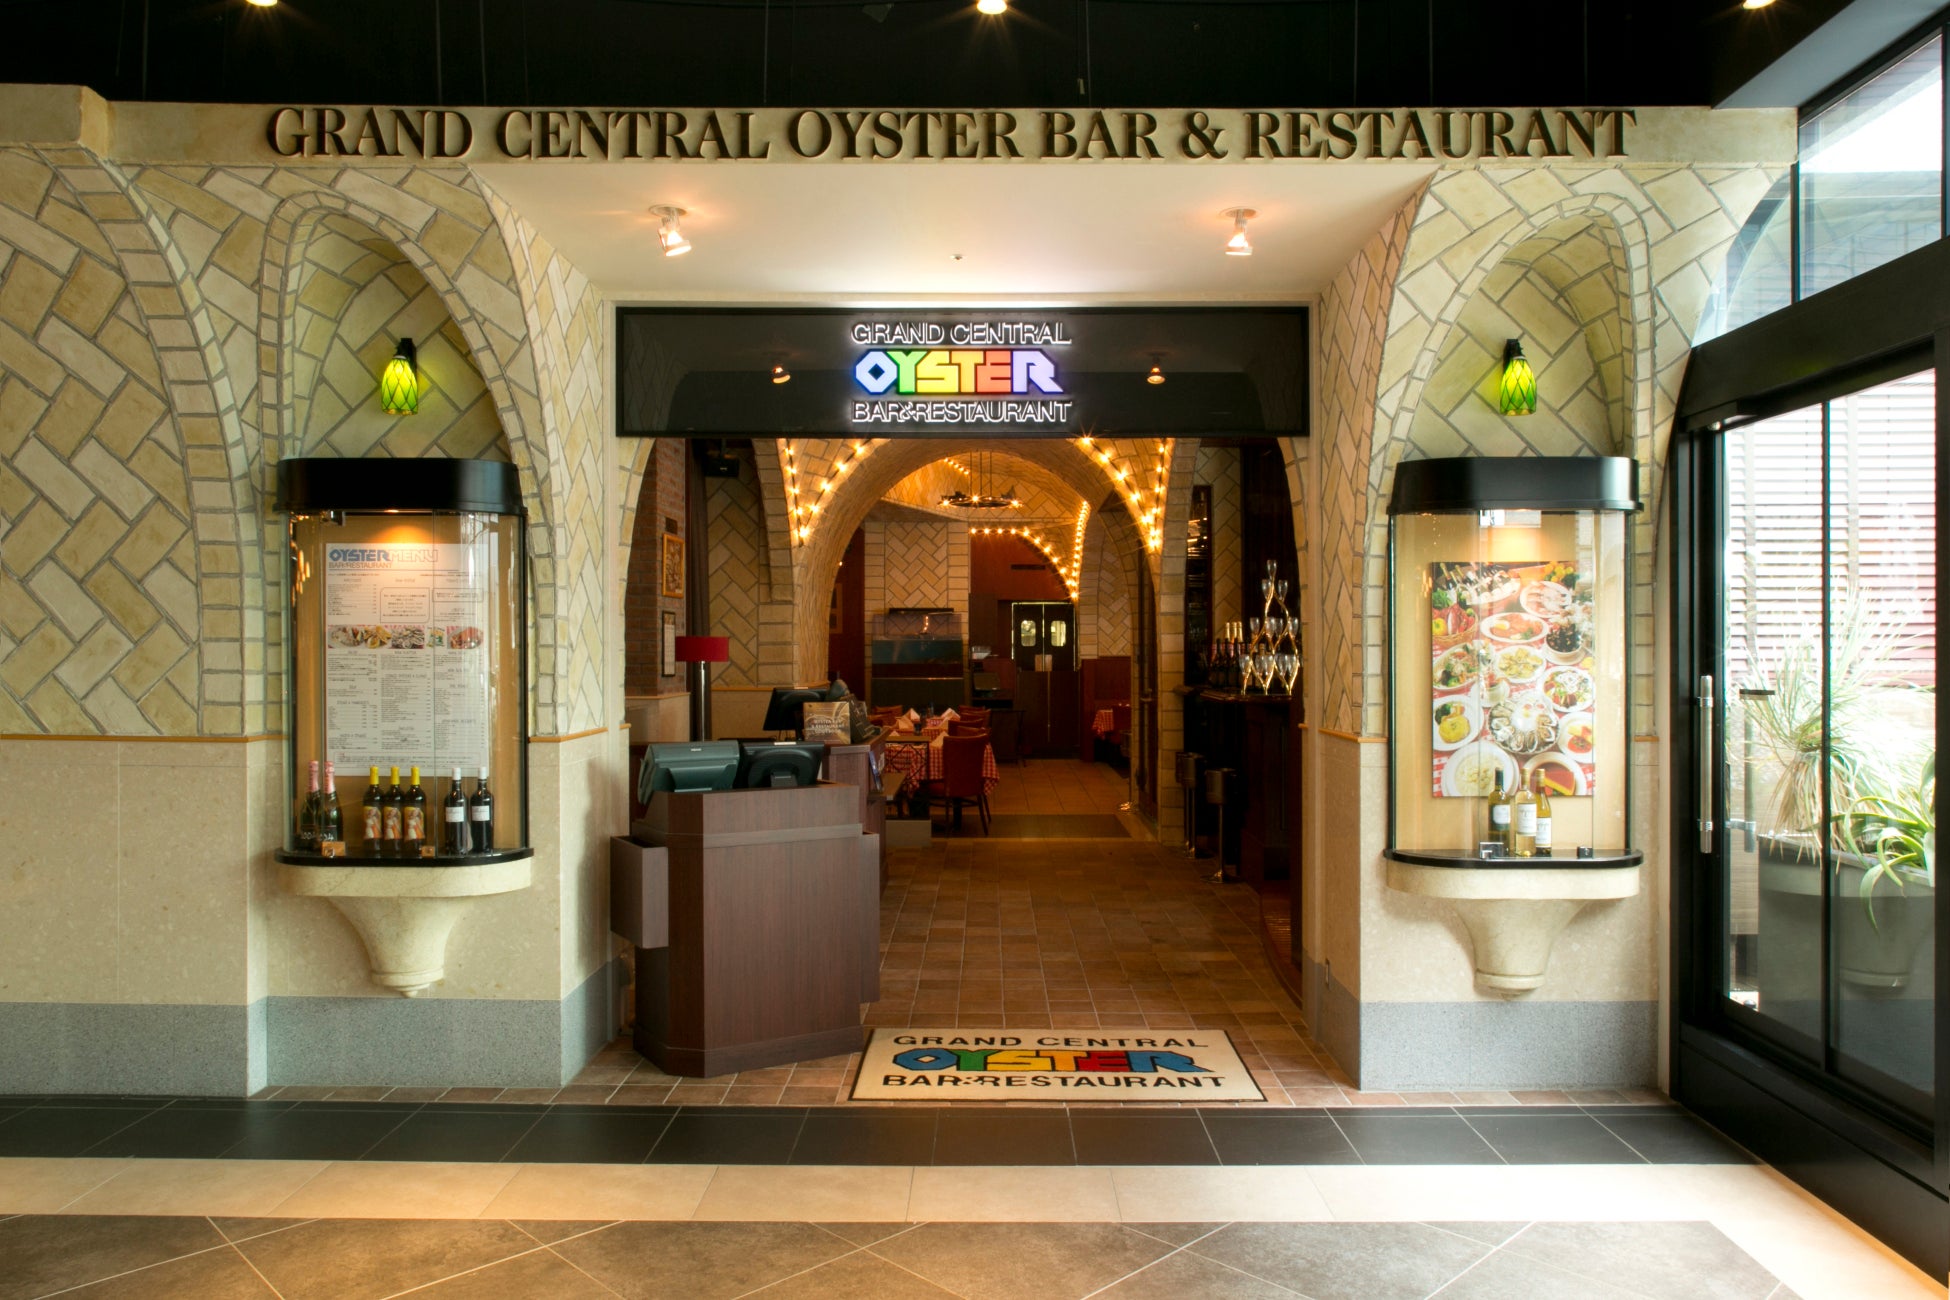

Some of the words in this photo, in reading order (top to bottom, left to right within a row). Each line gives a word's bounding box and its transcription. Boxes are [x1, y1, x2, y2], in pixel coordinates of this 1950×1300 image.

[266, 107, 474, 158] GRAND
[498, 108, 771, 160] CENTRAL
[787, 109, 1021, 160] OYSTER
[1039, 110, 1166, 160] BAR
[1180, 110, 1229, 161] &
[1243, 110, 1638, 160] RESTAURANT
[851, 321, 945, 345] GRAND
[950, 321, 1072, 345] CENTRAL
[854, 348, 1065, 395] OYSTER
[328, 548, 391, 562] OYSTER
[390, 549, 439, 563] MENU
[893, 1035, 1022, 1047] GRAND
[1037, 1036, 1209, 1048] CENTRAL
[892, 1047, 1216, 1073] OYSTER
